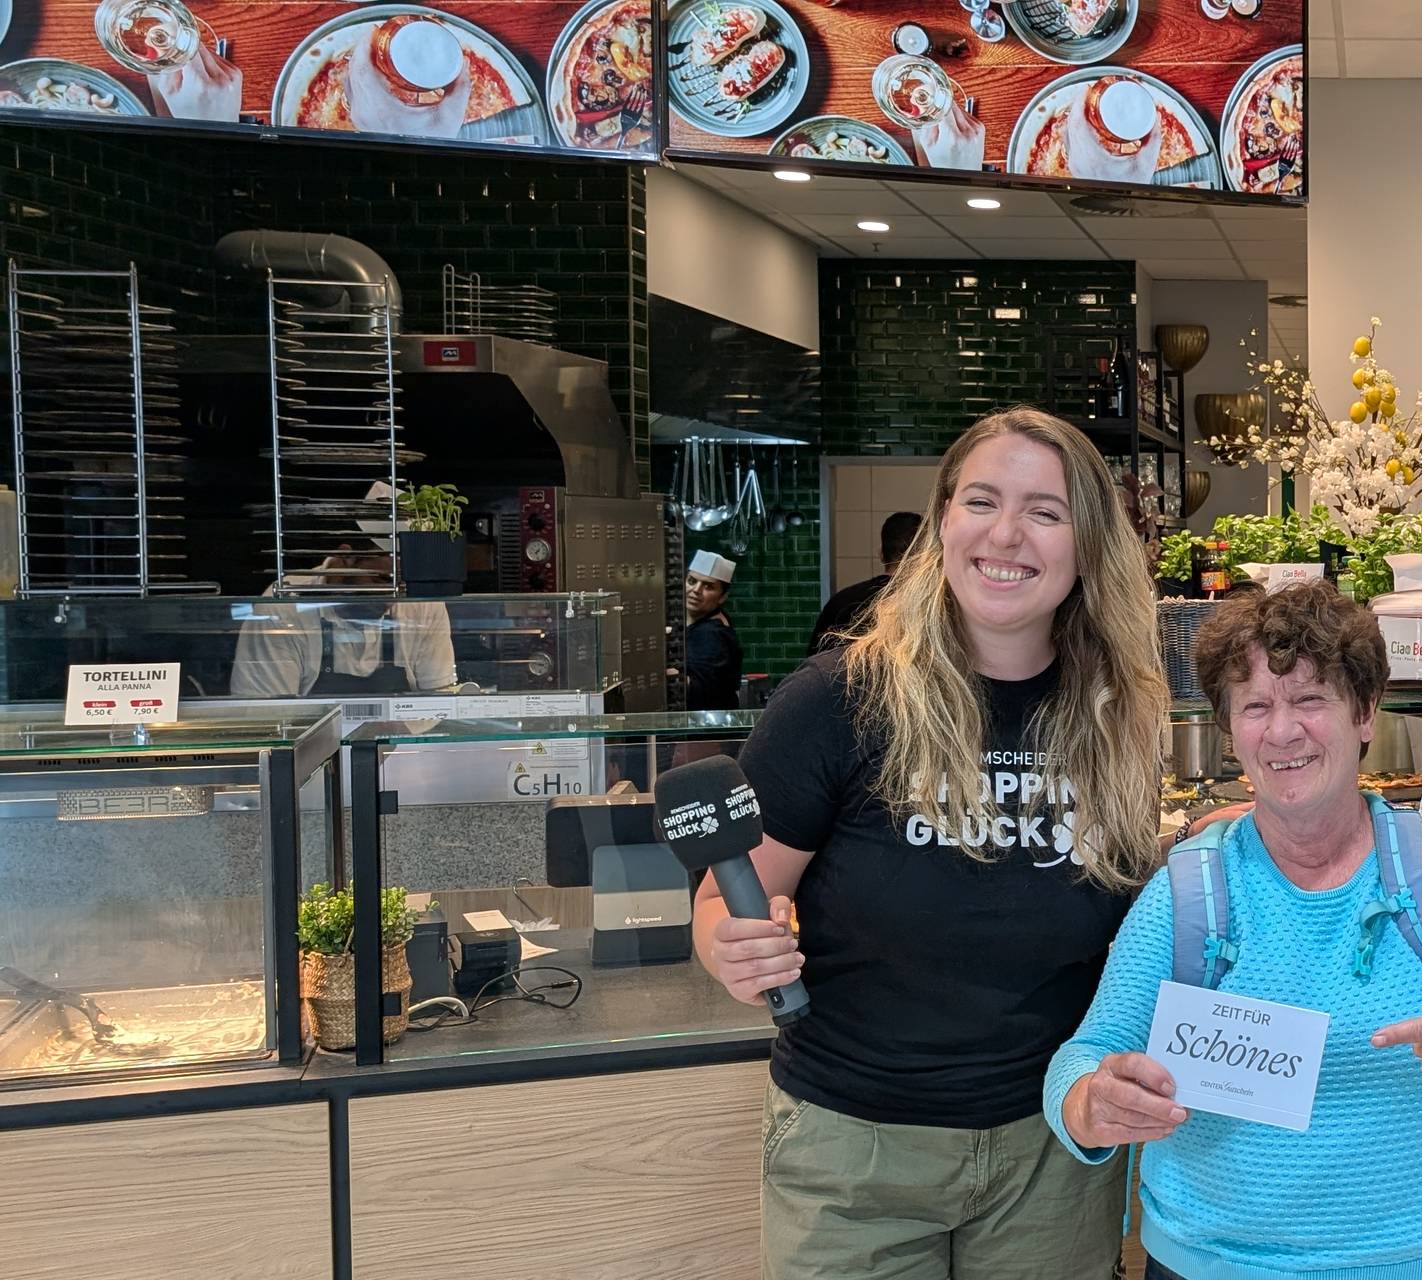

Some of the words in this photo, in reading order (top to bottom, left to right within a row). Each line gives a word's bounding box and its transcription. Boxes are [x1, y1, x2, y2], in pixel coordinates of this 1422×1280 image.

[1390, 640, 1411, 655] Ciao
[83, 670, 167, 682] TORTELLINI
[86, 709, 105, 717] 6,50
[979, 751, 1068, 766] MSCHEIDER
[663, 803, 716, 828] SHOPPING
[667, 822, 701, 840] GLÜCK
[906, 809, 1048, 848] GLÜCK
[1211, 1003, 1243, 1021] ZEIT
[1243, 1009, 1272, 1027] FÜR
[1165, 1022, 1303, 1080] Schönes
